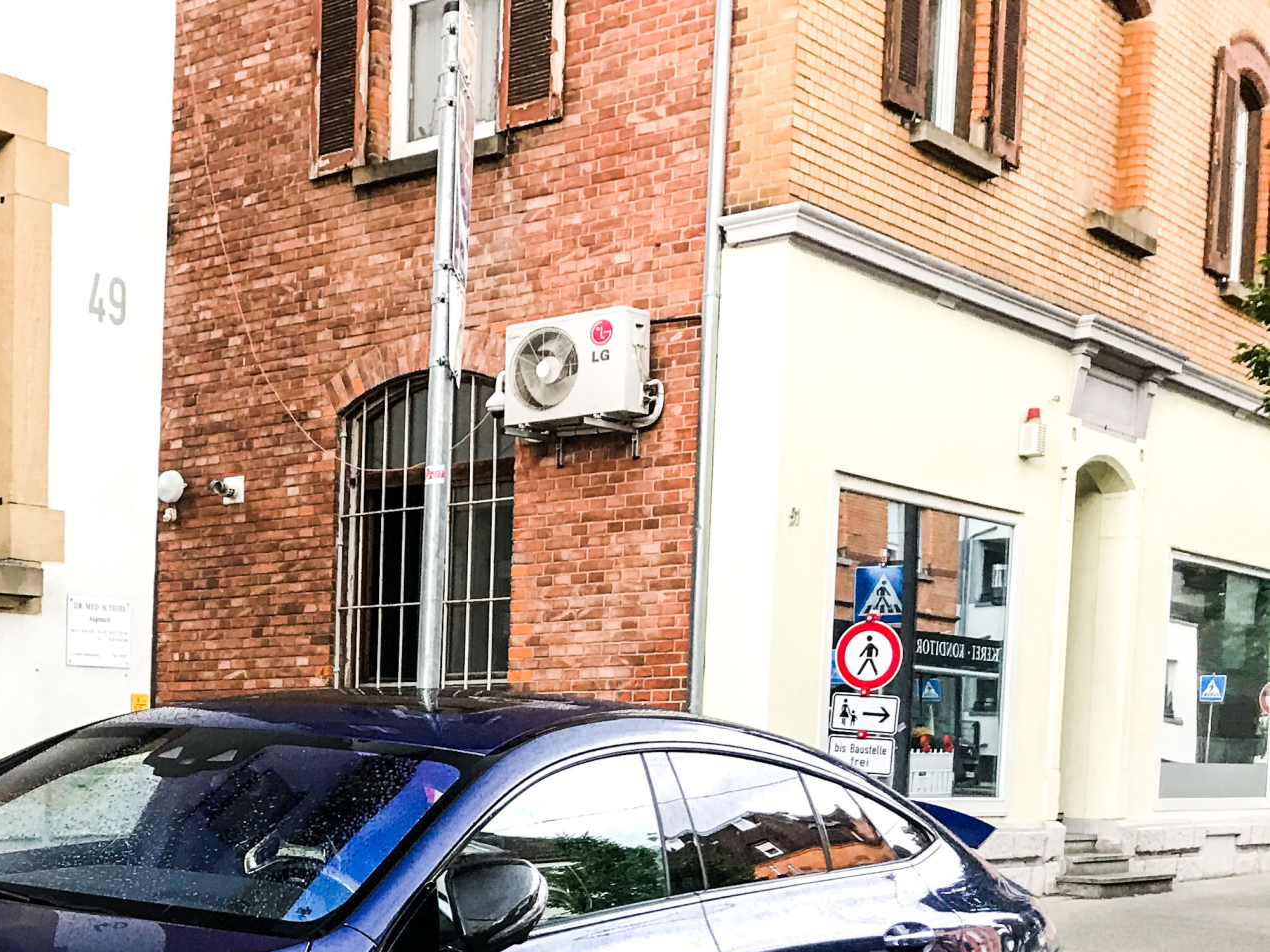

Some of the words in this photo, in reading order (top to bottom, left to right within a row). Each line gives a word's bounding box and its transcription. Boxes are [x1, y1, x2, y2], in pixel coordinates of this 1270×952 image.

[89, 272, 126, 326] 49
[591, 349, 610, 363] LG
[834, 743, 846, 753] bis
[850, 743, 887, 756] Baustelle
[850, 756, 869, 767] frei
